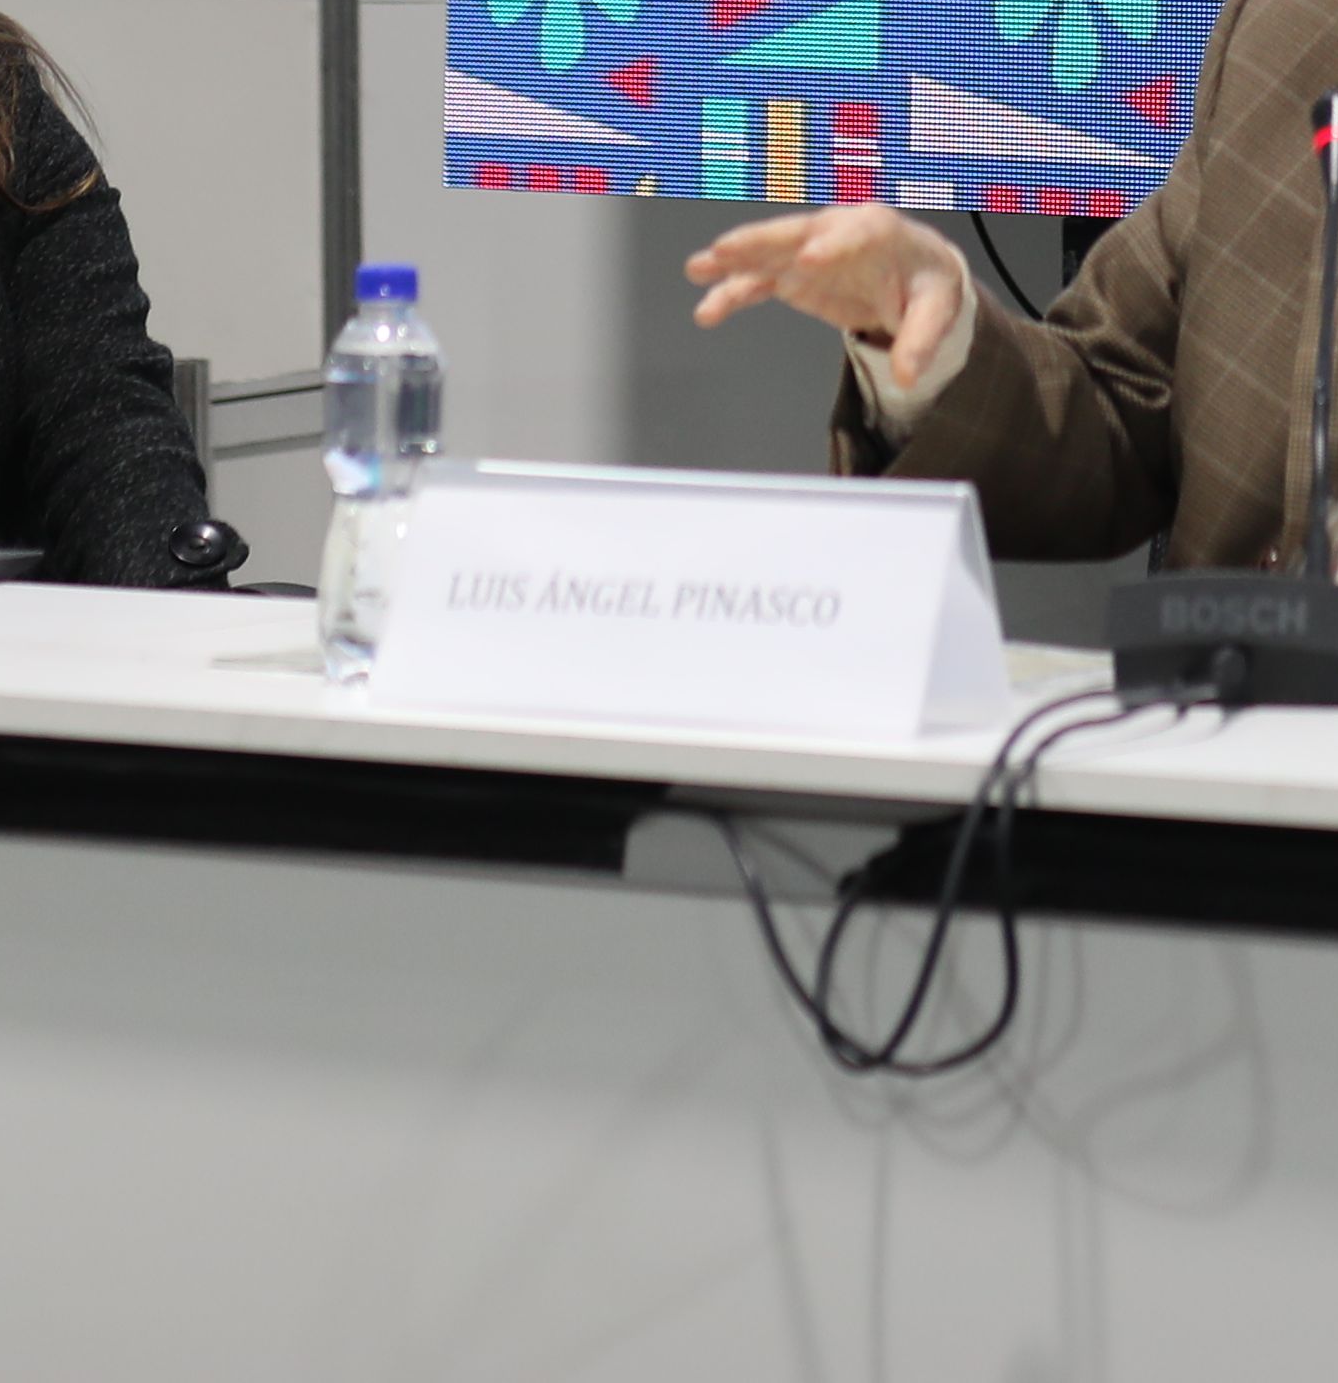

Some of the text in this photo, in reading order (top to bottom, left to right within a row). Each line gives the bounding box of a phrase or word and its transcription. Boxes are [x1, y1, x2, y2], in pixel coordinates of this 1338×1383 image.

[446, 568, 843, 628] LUIS ÁNGEL PINASCO
[1160, 594, 1307, 634] BOSCH
